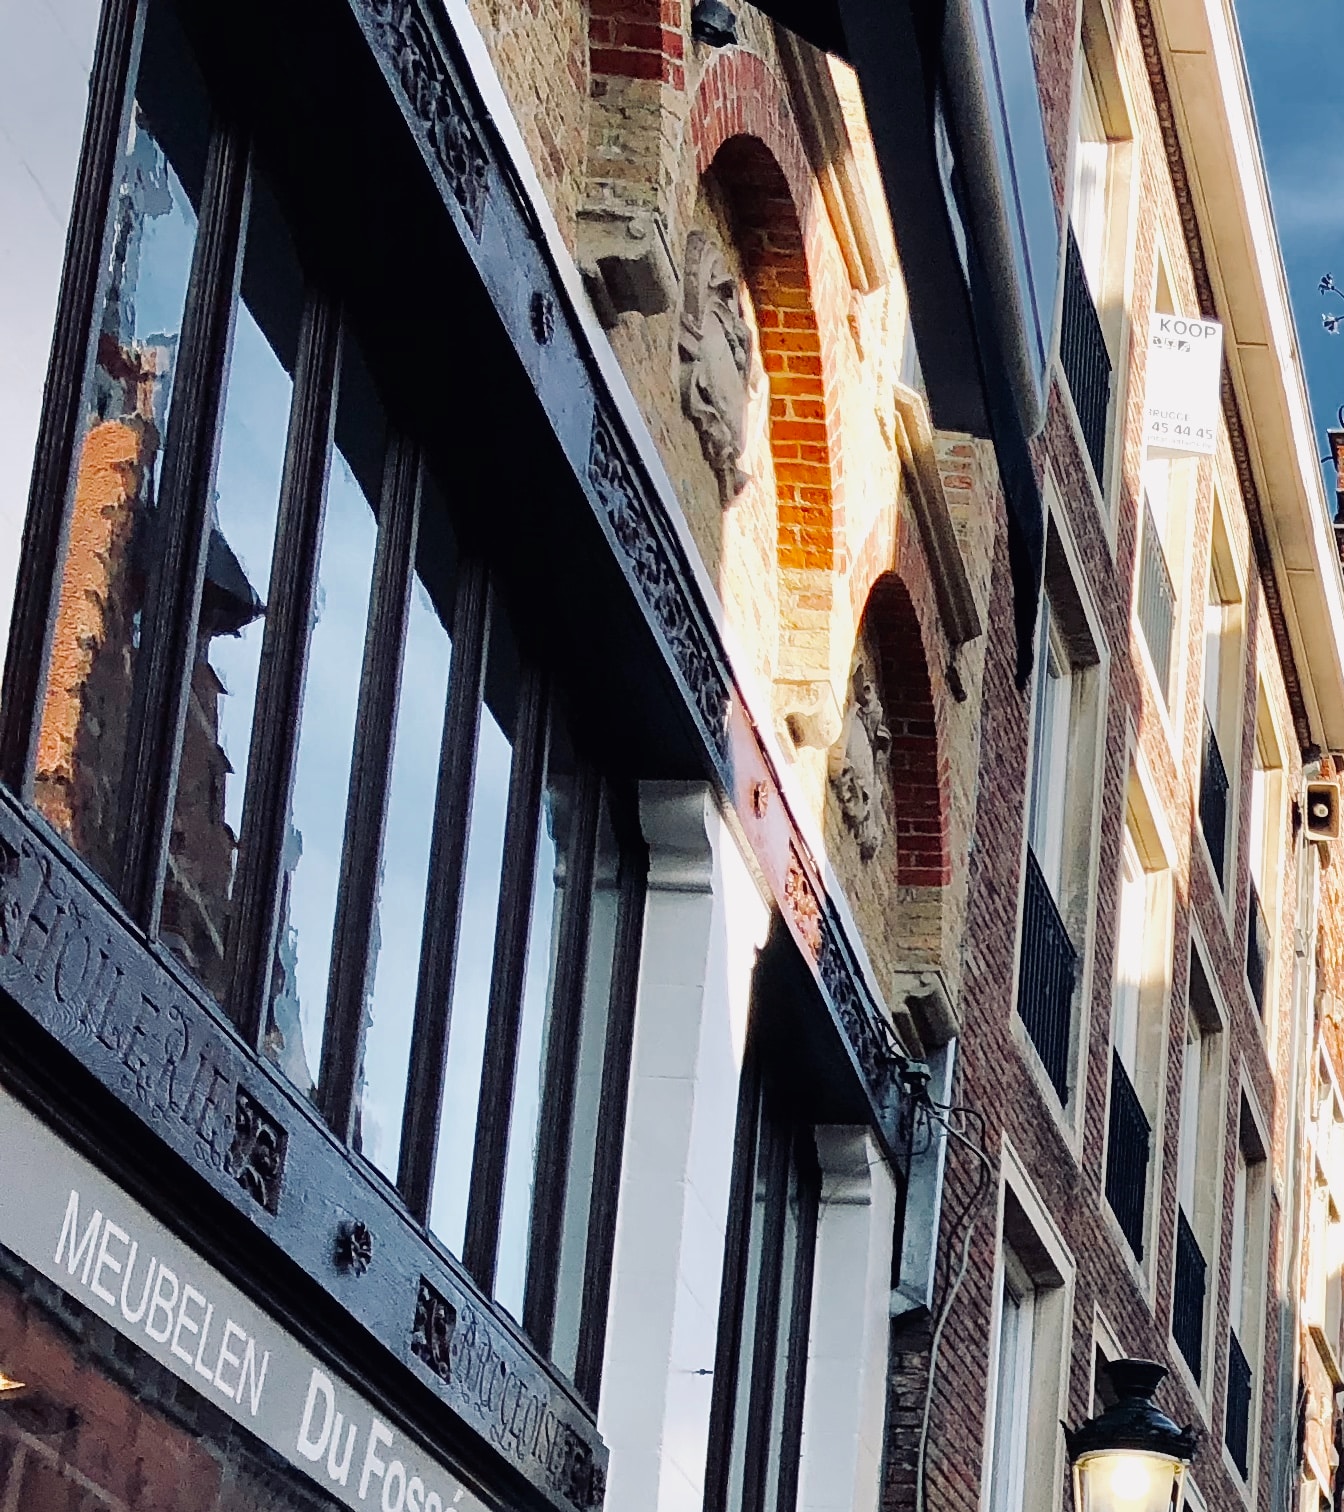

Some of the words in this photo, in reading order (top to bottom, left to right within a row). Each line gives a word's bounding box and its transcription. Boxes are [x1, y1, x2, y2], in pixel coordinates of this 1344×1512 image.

[1160, 318, 1217, 339] KOOP
[1151, 421, 1169, 434] 45
[1173, 424, 1191, 436] 44
[1196, 428, 1213, 440] 45
[54, 1190, 272, 1416] MEUBELEN
[297, 1368, 357, 1486] Du
